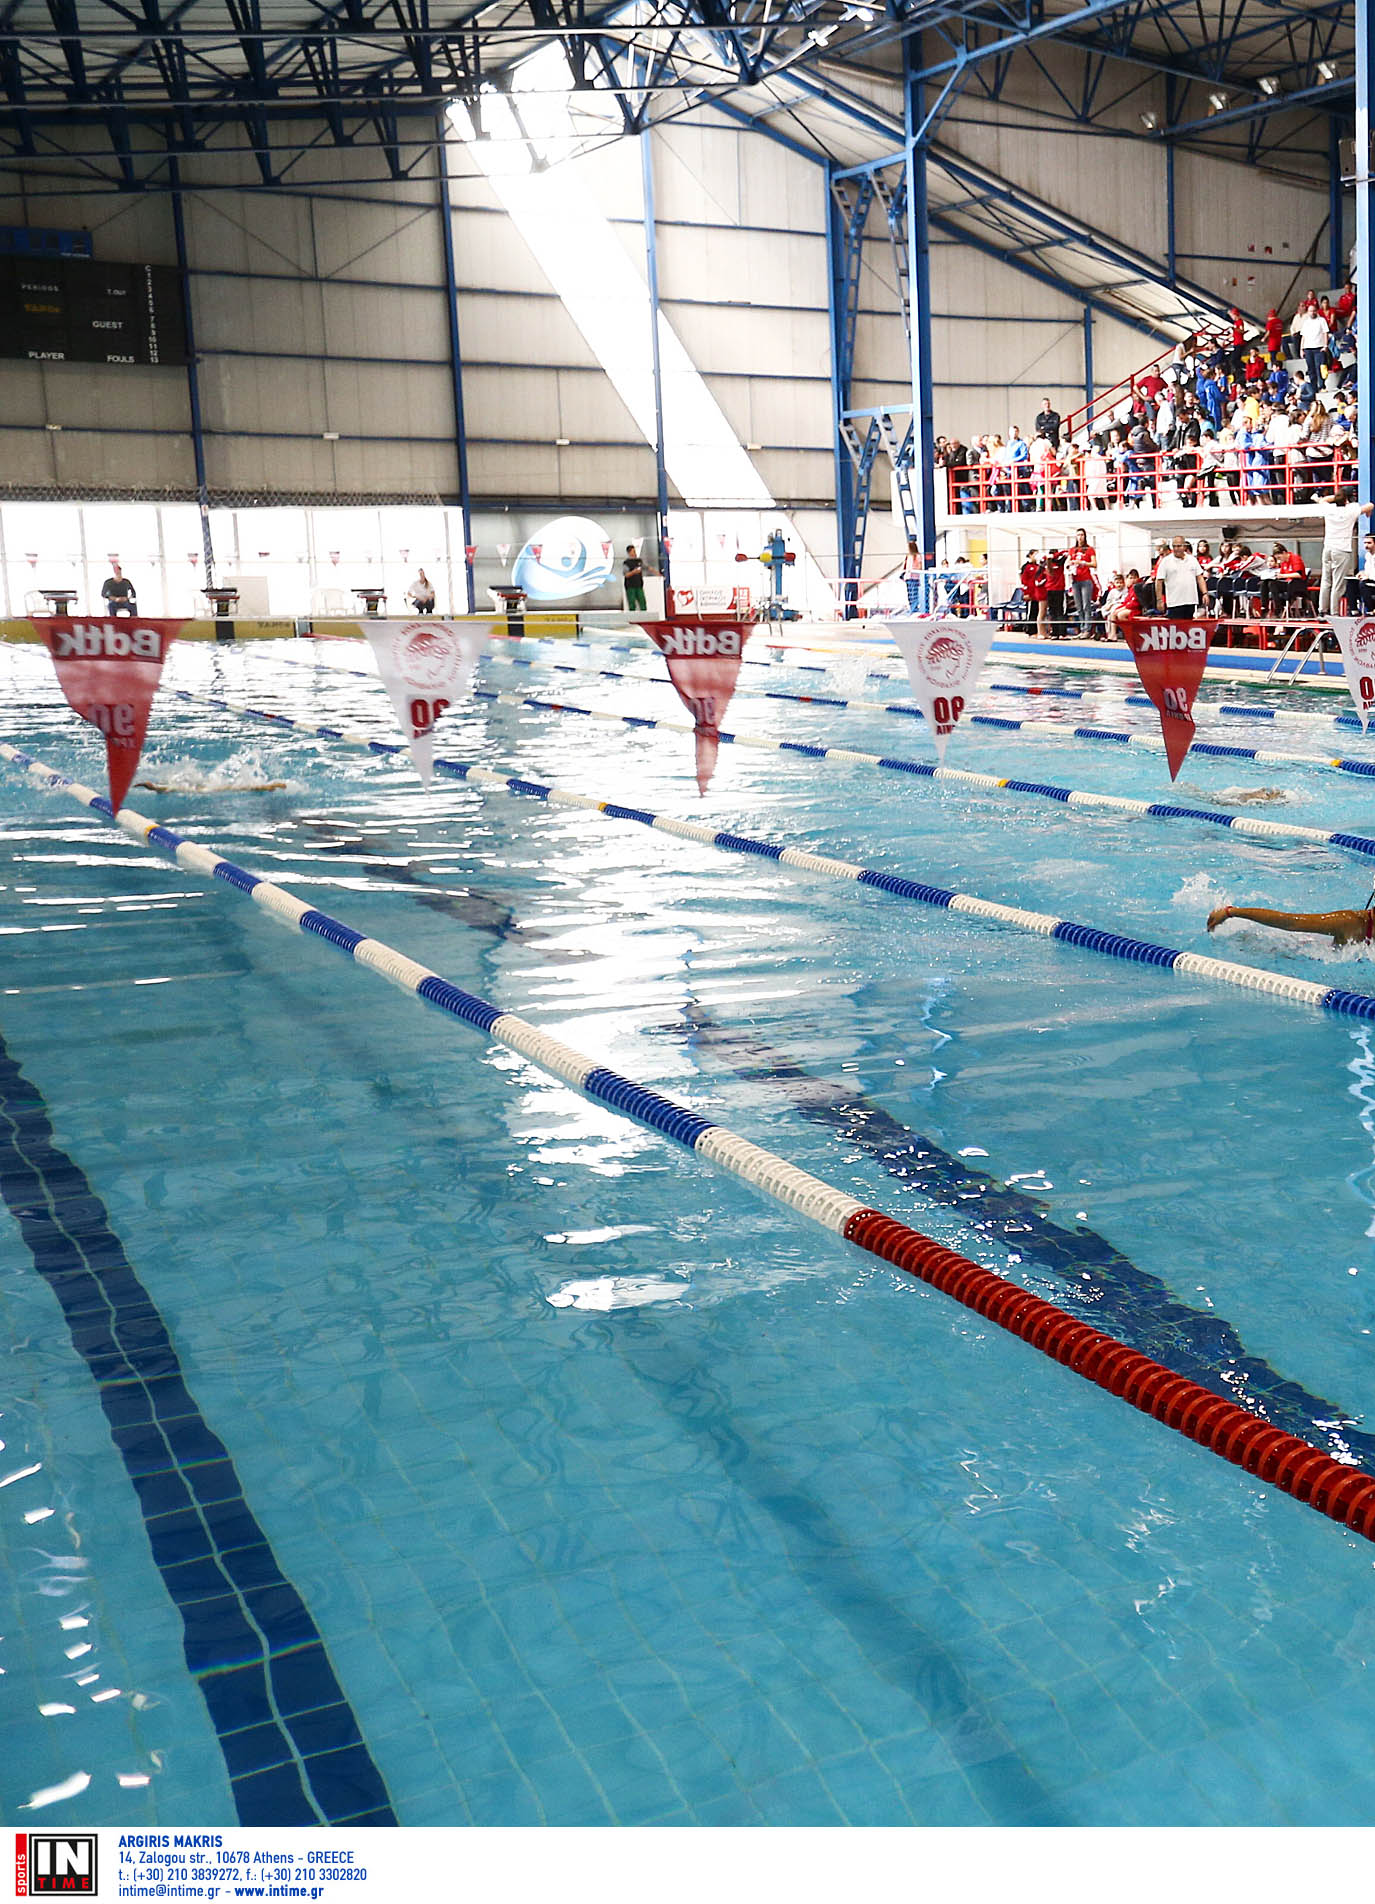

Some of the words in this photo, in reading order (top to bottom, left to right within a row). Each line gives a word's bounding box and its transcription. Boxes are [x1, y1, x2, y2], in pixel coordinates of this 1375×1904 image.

[92, 321, 124, 329] GUEST
[28, 351, 65, 360] PLAYER
[107, 354, 135, 364] FOULS
